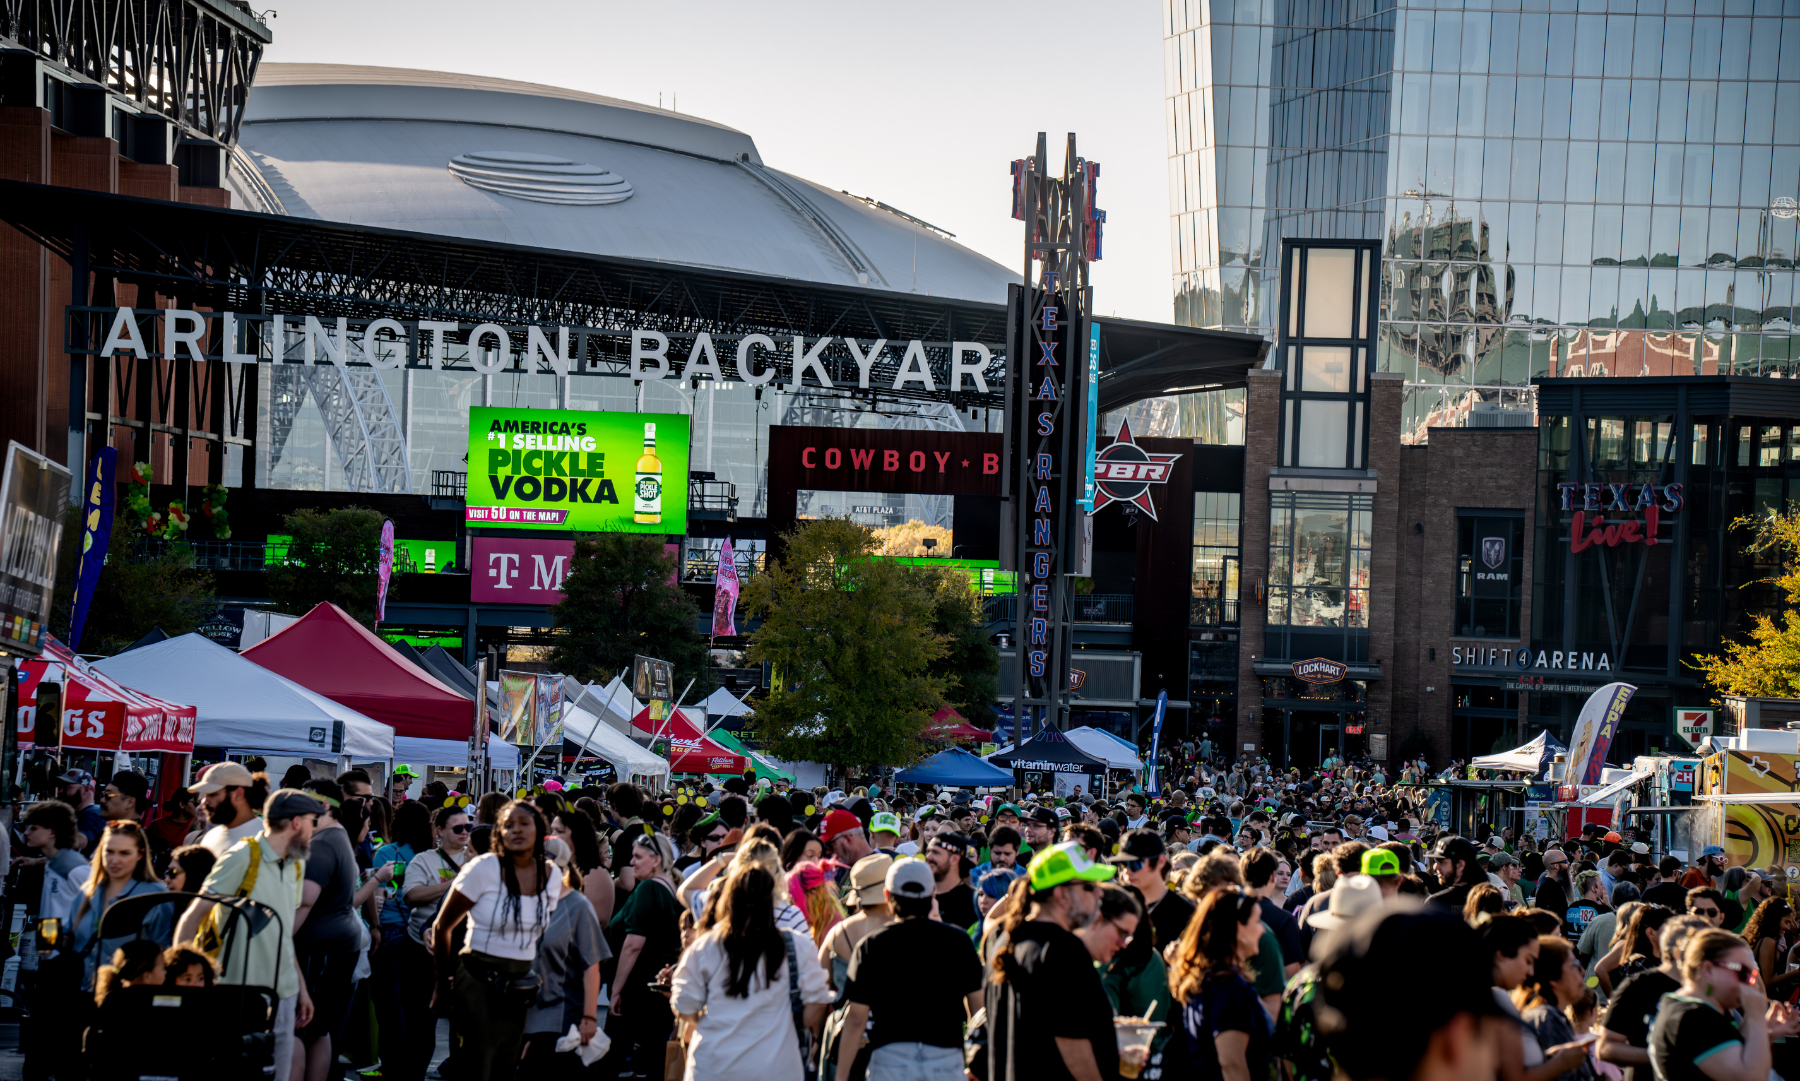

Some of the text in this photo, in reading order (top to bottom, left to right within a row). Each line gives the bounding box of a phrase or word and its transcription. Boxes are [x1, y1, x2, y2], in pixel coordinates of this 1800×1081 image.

[100, 306, 991, 394] ARLINGTON BACKYAR
[489, 419, 587, 436] AMERICA'S
[487, 431, 597, 452] #1 SELLING
[488, 448, 606, 479] PICKLE
[802, 446, 999, 475] COWBOY B
[1095, 463, 1166, 480] PBR
[1030, 271, 1060, 678] TEXAS RANGERS
[488, 474, 620, 504] VODKA
[639, 490, 657, 498] SHOT
[1557, 482, 1684, 513] TEXAS
[468, 508, 489, 519] VISIT
[491, 506, 507, 520] 50
[509, 511, 521, 521] ON
[522, 511, 537, 521] THE
[855, 506, 871, 514] AT&T
[1571, 504, 1660, 554] Live!
[529, 555, 568, 591] M
[1298, 662, 1341, 677] LOCKHART
[1452, 646, 1512, 666] SHIFT
[1535, 650, 1611, 671] ARENA
[1506, 682, 1515, 690] THE
[1515, 683, 1535, 691] CAPITAL
[1542, 684, 1560, 692] SPORTS
[1565, 685, 1600, 693] ENTERTAINME
[1684, 712, 1707, 742] 7
